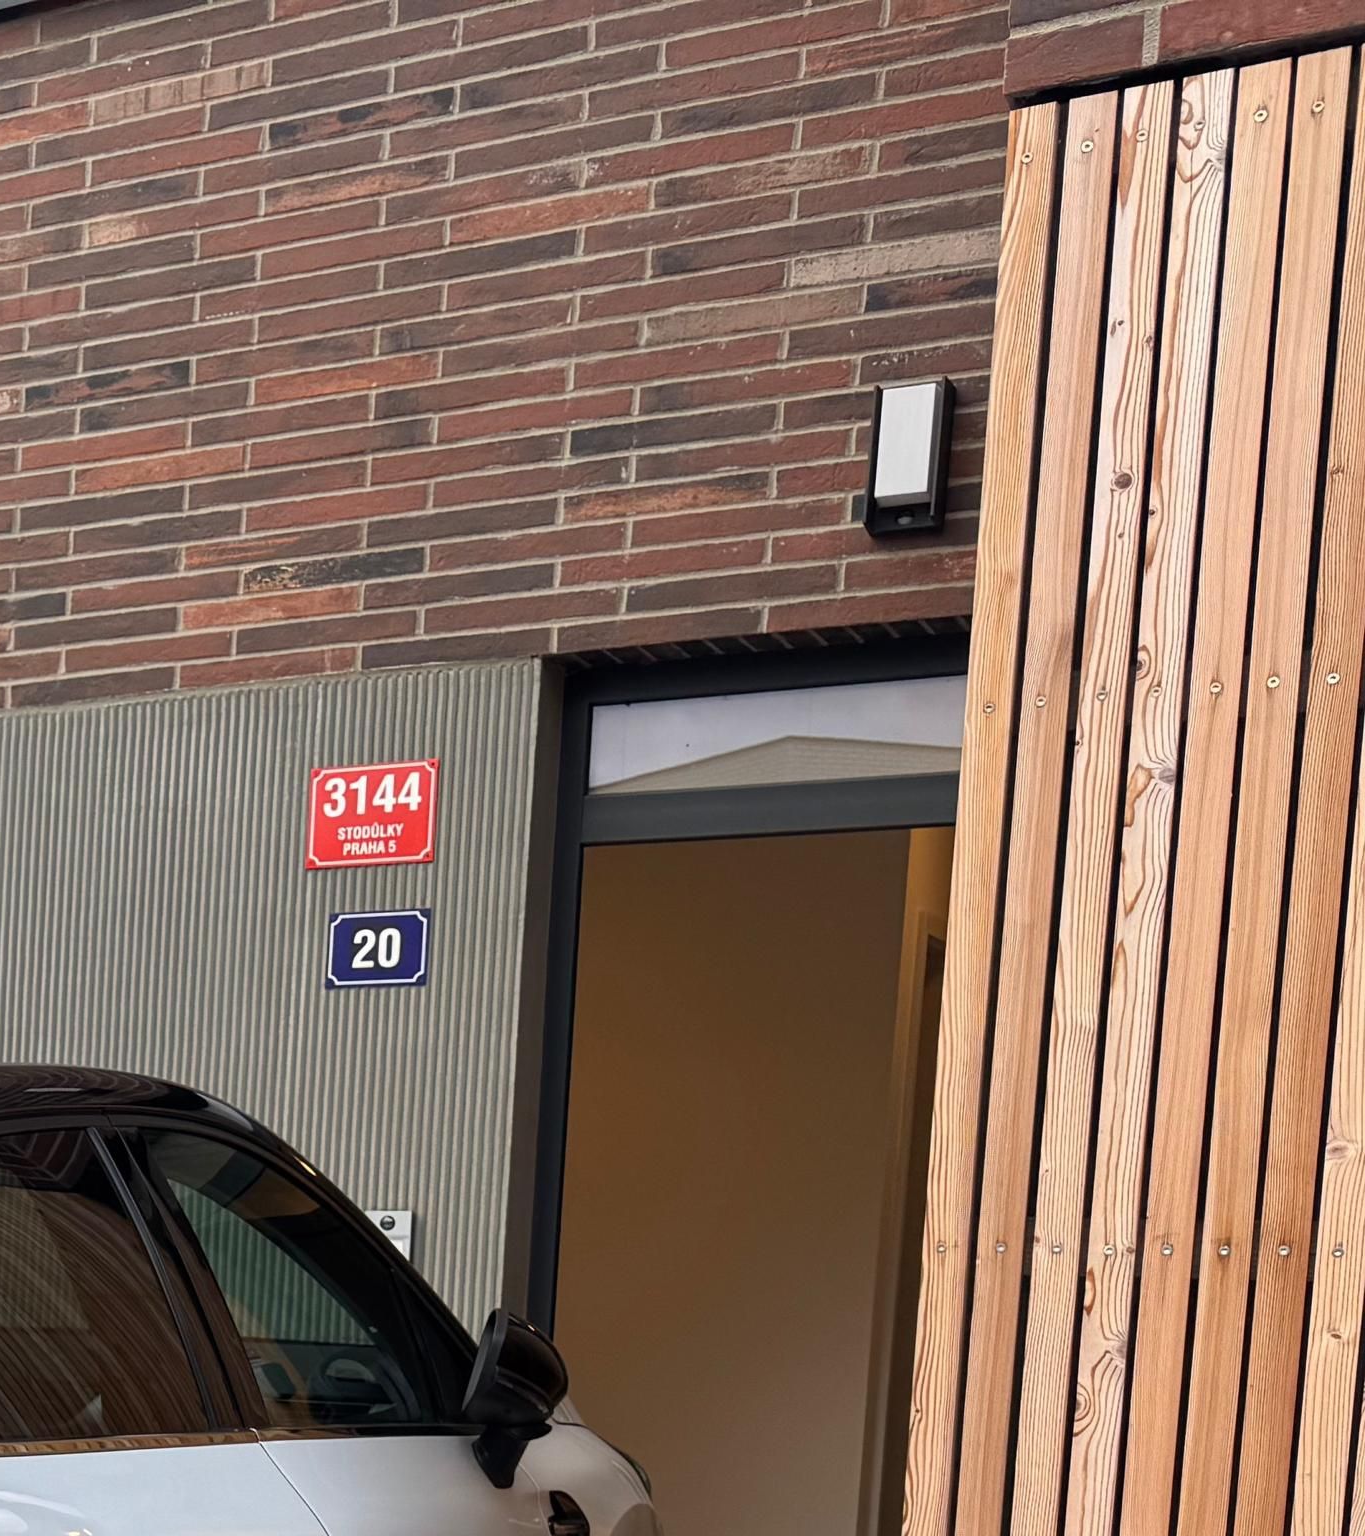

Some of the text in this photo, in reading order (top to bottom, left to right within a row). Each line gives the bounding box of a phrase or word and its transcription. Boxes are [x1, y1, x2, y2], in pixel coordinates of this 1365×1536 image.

[323, 771, 422, 818] 3144
[337, 822, 404, 841] STODŮLKY
[343, 839, 397, 856] PRAHA 5
[351, 927, 402, 969] 20
